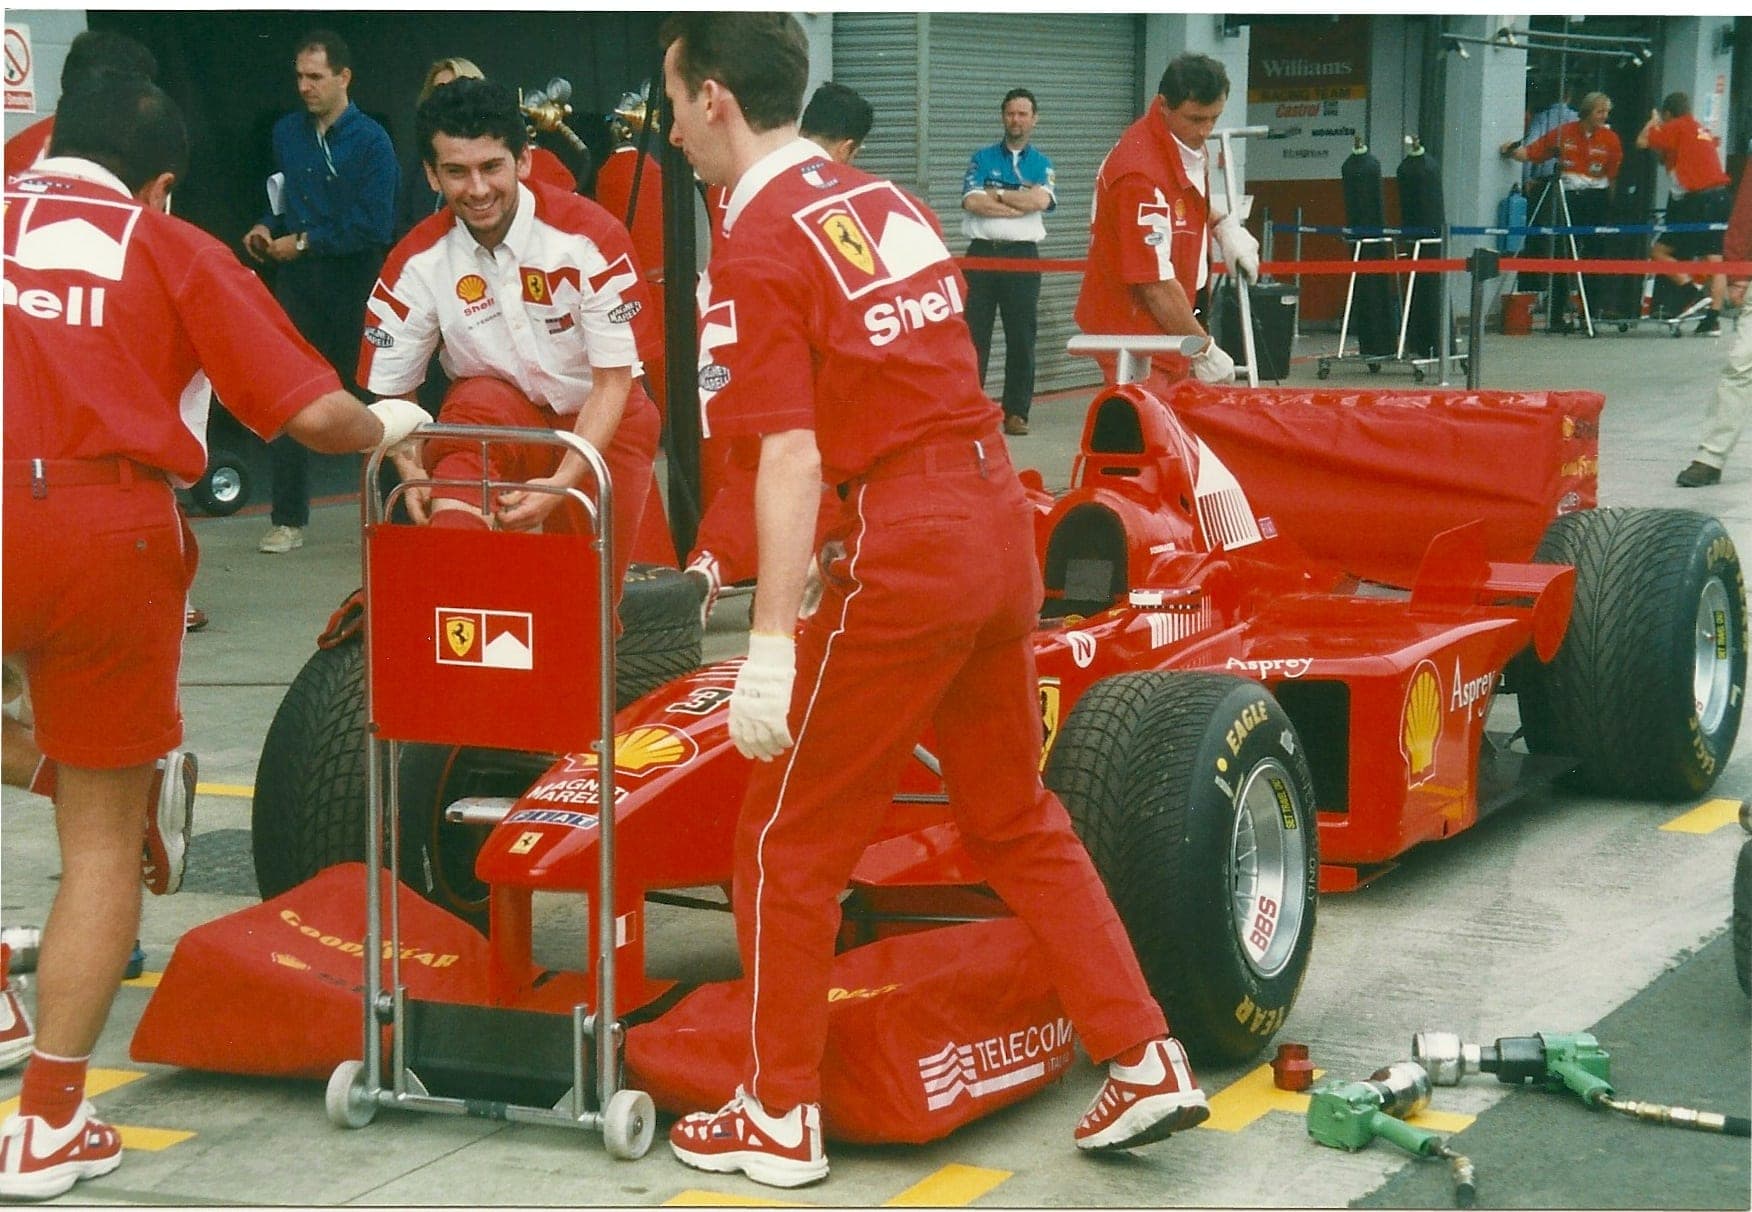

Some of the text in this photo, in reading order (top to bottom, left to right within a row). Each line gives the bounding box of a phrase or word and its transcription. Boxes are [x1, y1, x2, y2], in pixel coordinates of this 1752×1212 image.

[1262, 58, 1352, 77] Williams
[1275, 103, 1320, 118] Castrol
[3, 279, 105, 327] ell
[463, 297, 496, 317] Shell
[864, 276, 964, 346] Shell
[1225, 656, 1314, 680] Asprey
[1450, 654, 1497, 724] Asprey
[1226, 700, 1269, 757] EAGLE
[508, 811, 598, 828] FIAT
[1250, 896, 1278, 952] BBS
[974, 1017, 1073, 1073] TELECOM
